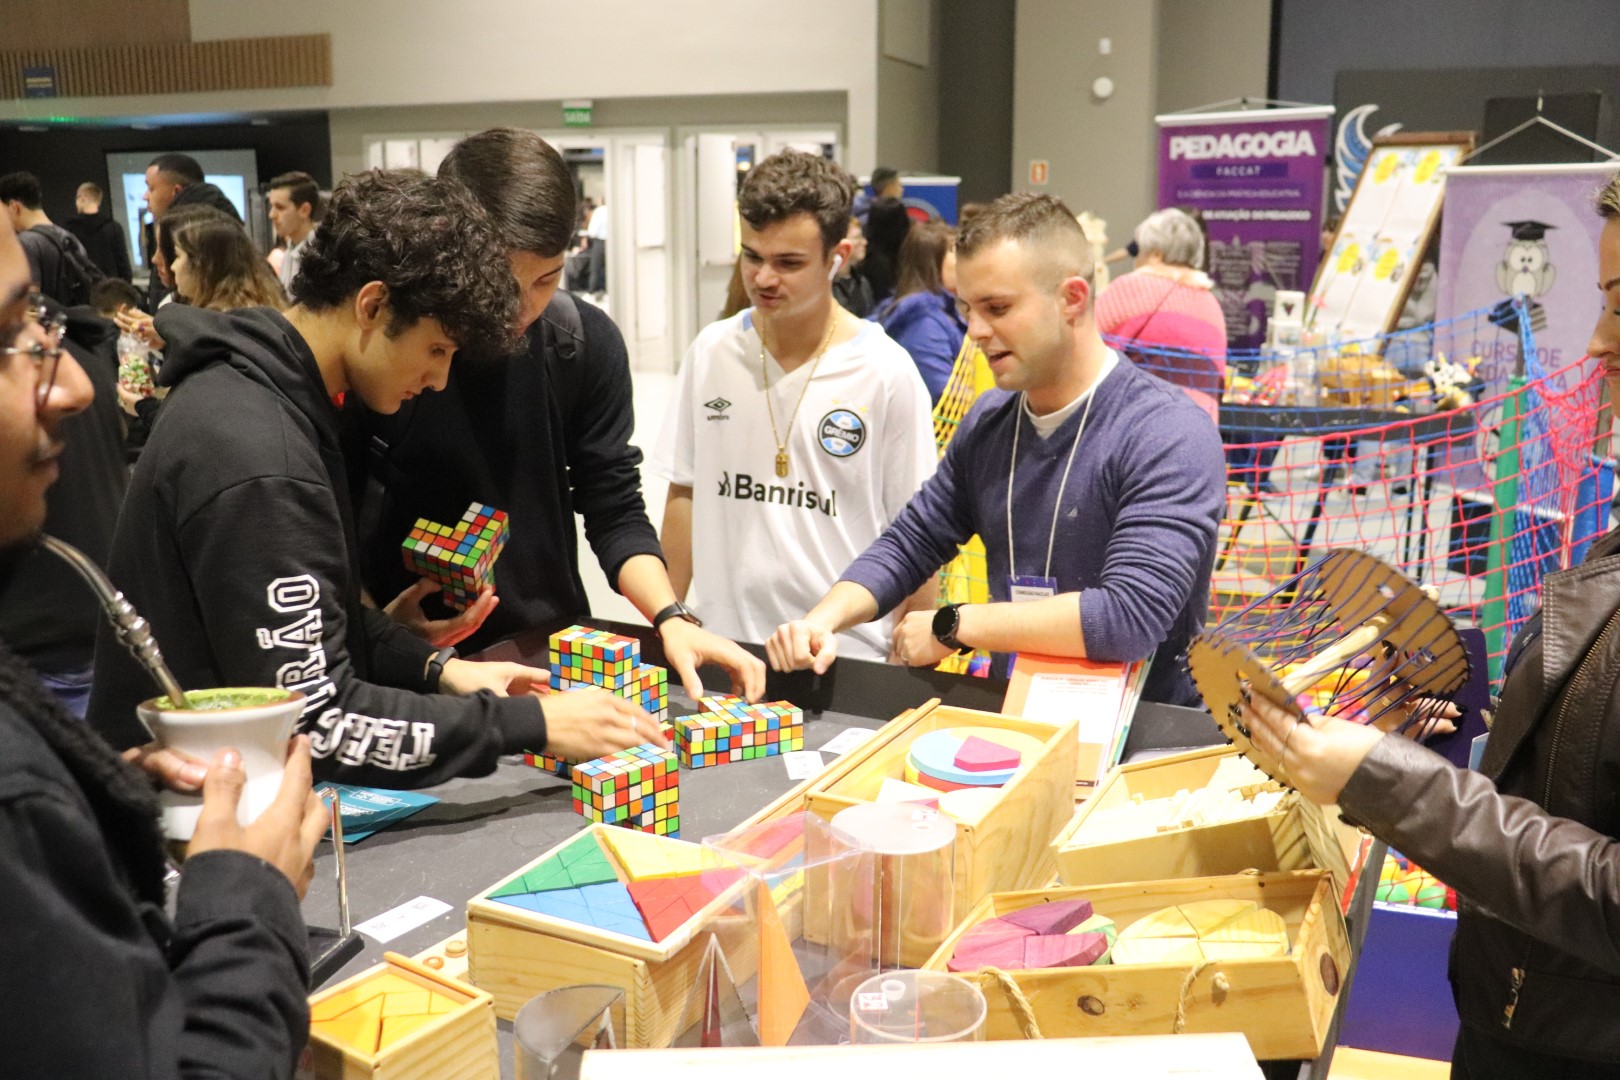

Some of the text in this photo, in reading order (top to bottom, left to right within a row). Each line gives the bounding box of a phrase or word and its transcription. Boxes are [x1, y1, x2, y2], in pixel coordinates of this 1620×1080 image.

[1169, 130, 1316, 161] PEDAGOGIA
[1215, 165, 1262, 176] FACCAT
[1472, 340, 1530, 363] CURS
[823, 425, 860, 443] GRÊMIO
[735, 474, 837, 517] Banrisul
